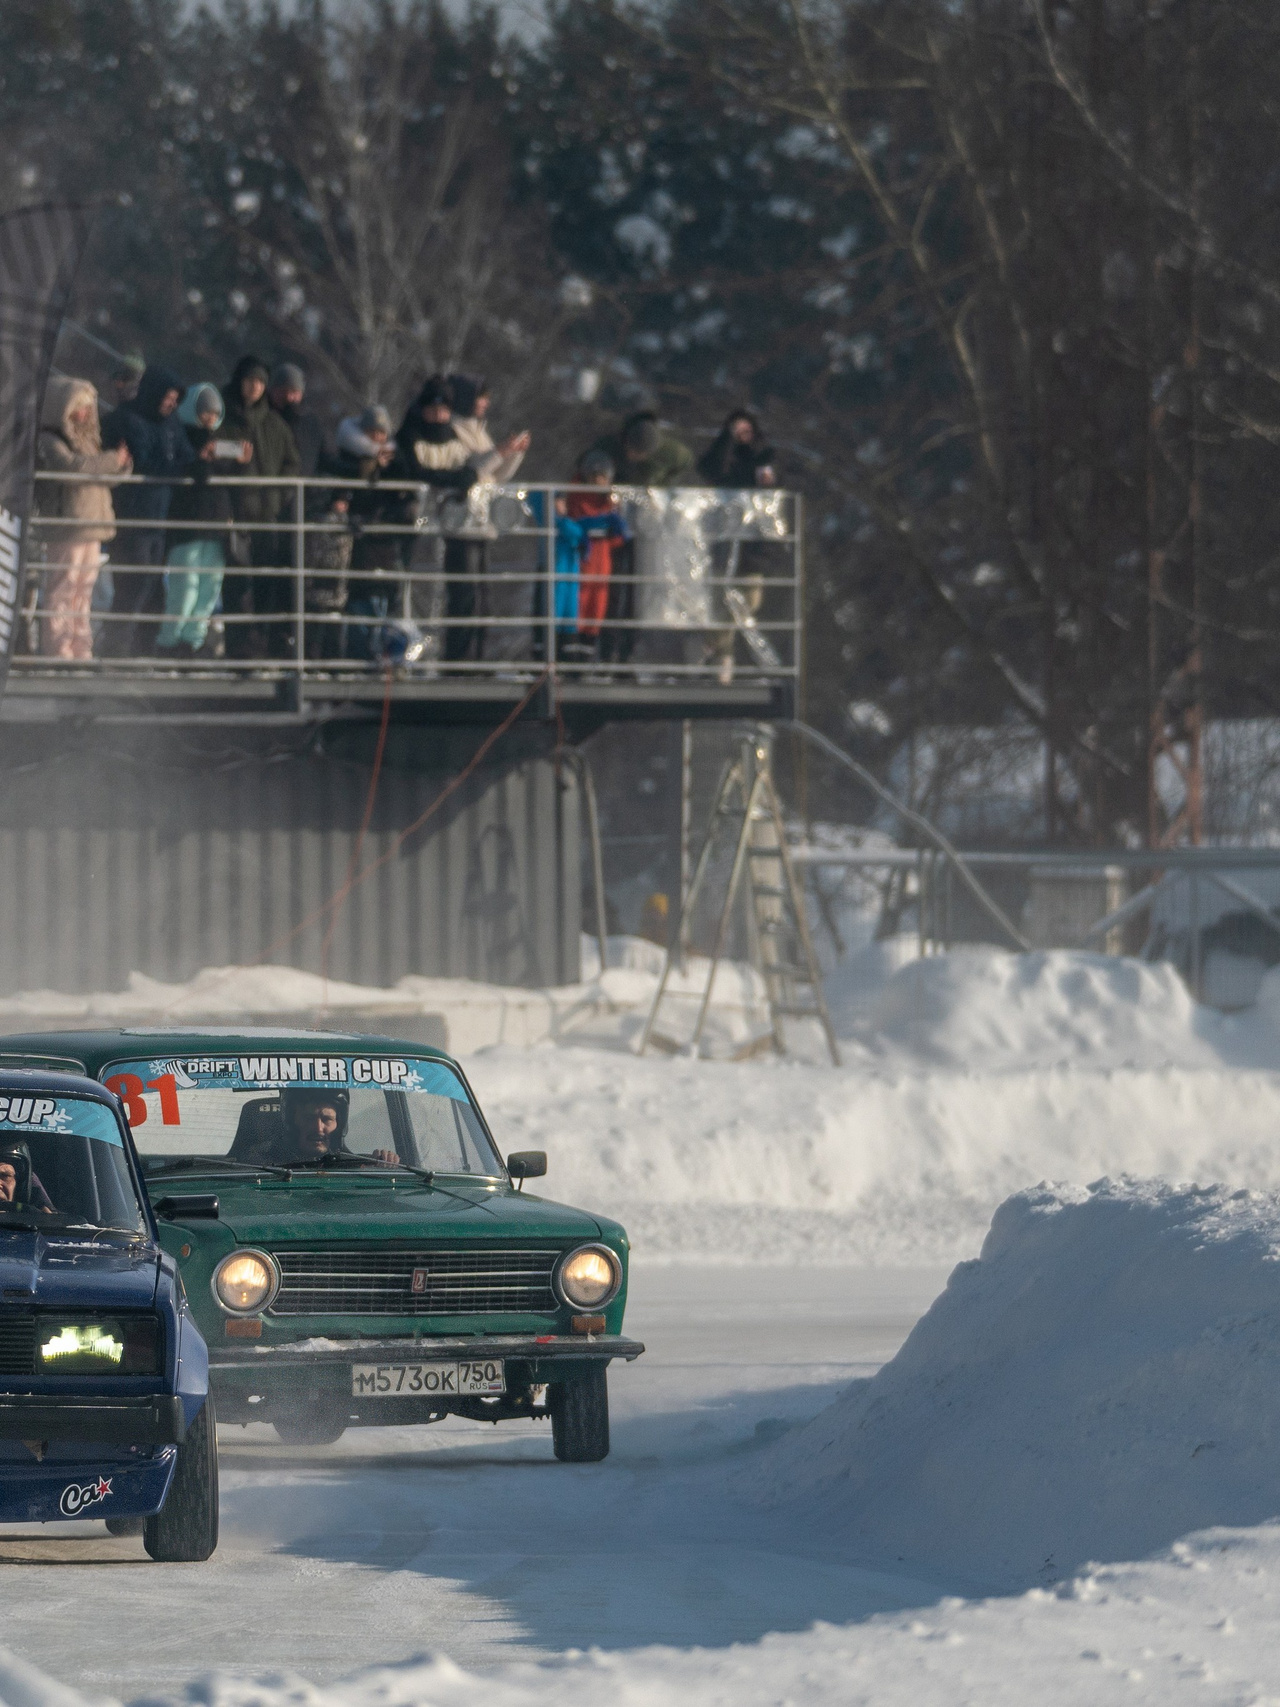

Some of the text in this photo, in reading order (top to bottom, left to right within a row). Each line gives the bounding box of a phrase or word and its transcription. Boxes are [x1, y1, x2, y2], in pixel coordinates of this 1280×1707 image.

[187, 1061, 237, 1073] DRIFT
[239, 1057, 408, 1084] WINTER CUP
[104, 1073, 180, 1126] 81
[460, 1362, 497, 1383] 750
[470, 1382, 488, 1390] RUS
